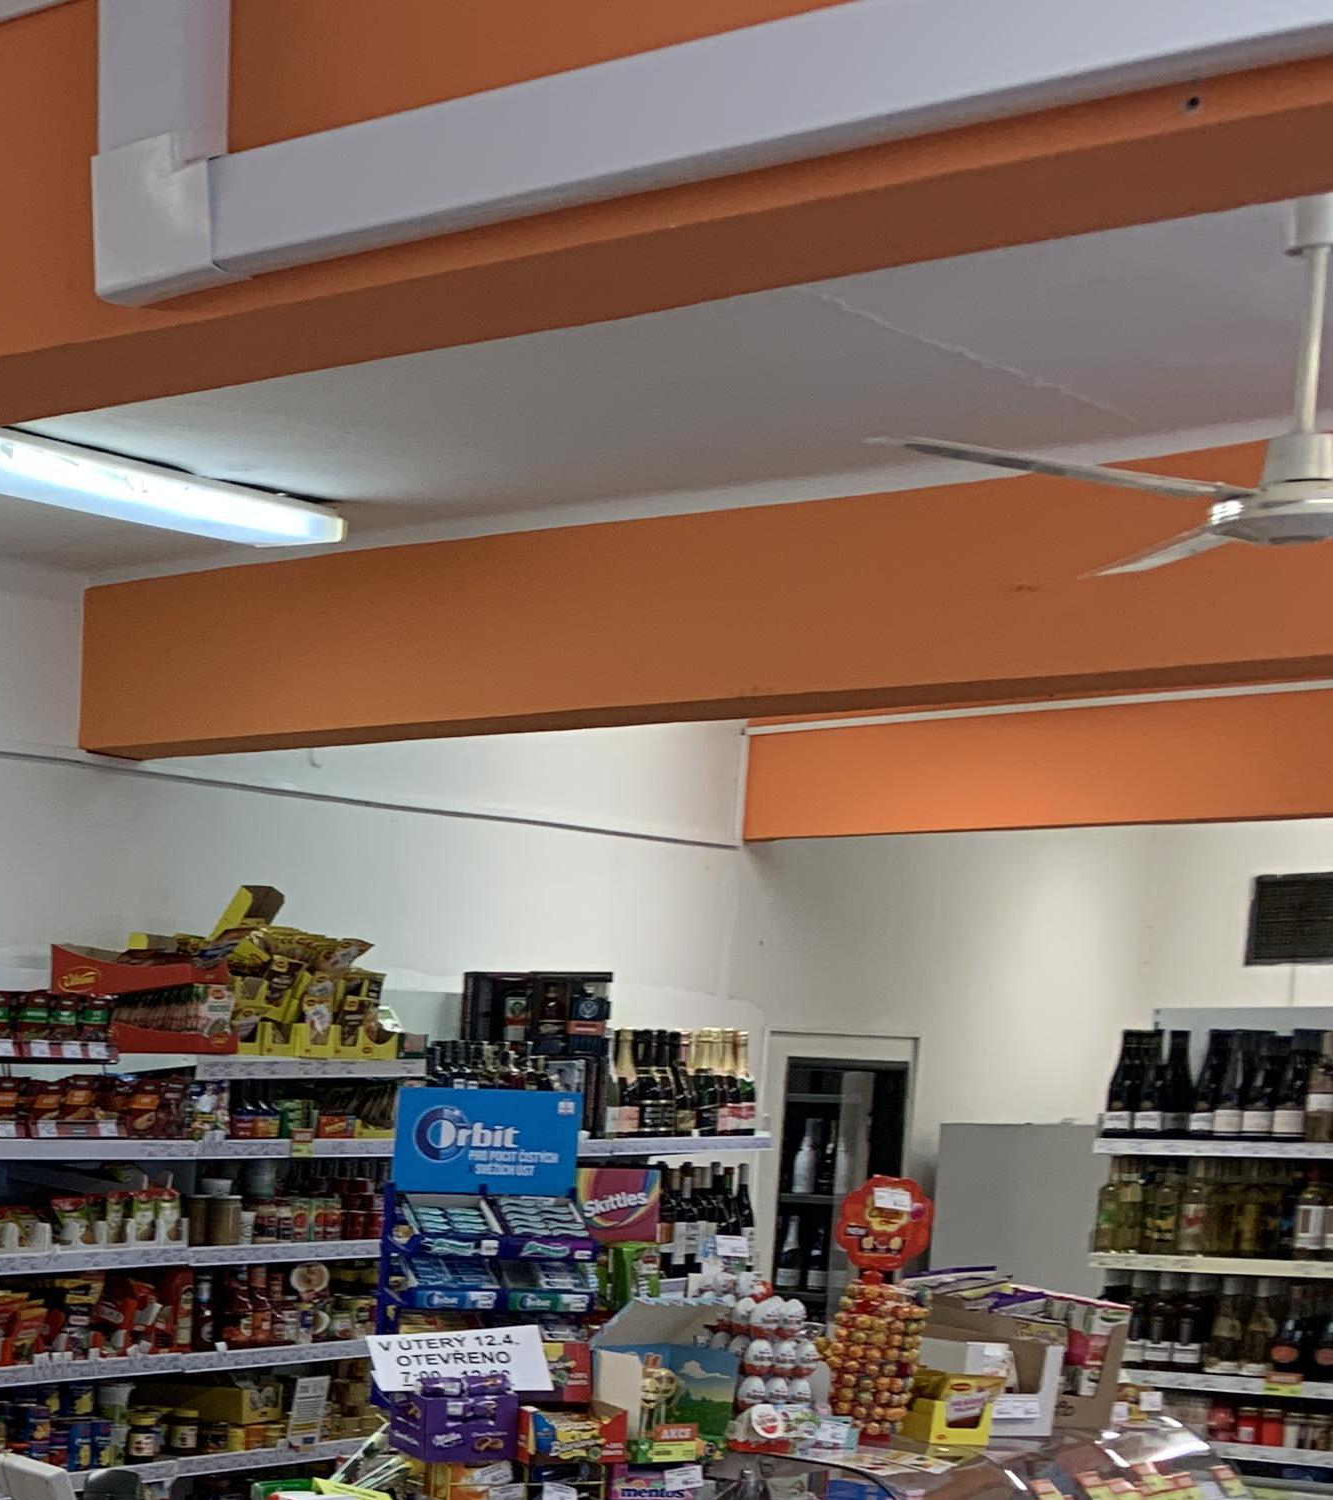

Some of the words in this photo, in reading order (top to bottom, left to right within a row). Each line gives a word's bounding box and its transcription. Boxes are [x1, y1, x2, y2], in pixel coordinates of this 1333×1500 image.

[421, 1113, 520, 1154] Orbit
[584, 1192, 649, 1218] Skittles
[378, 1341, 391, 1351] V
[398, 1334, 466, 1351] ÚTERÝ
[474, 1334, 520, 1347] 12.4.
[396, 1350, 511, 1367] OTEVŘENO
[661, 1427, 692, 1439] AKCE
[621, 1486, 685, 1499] mentos
